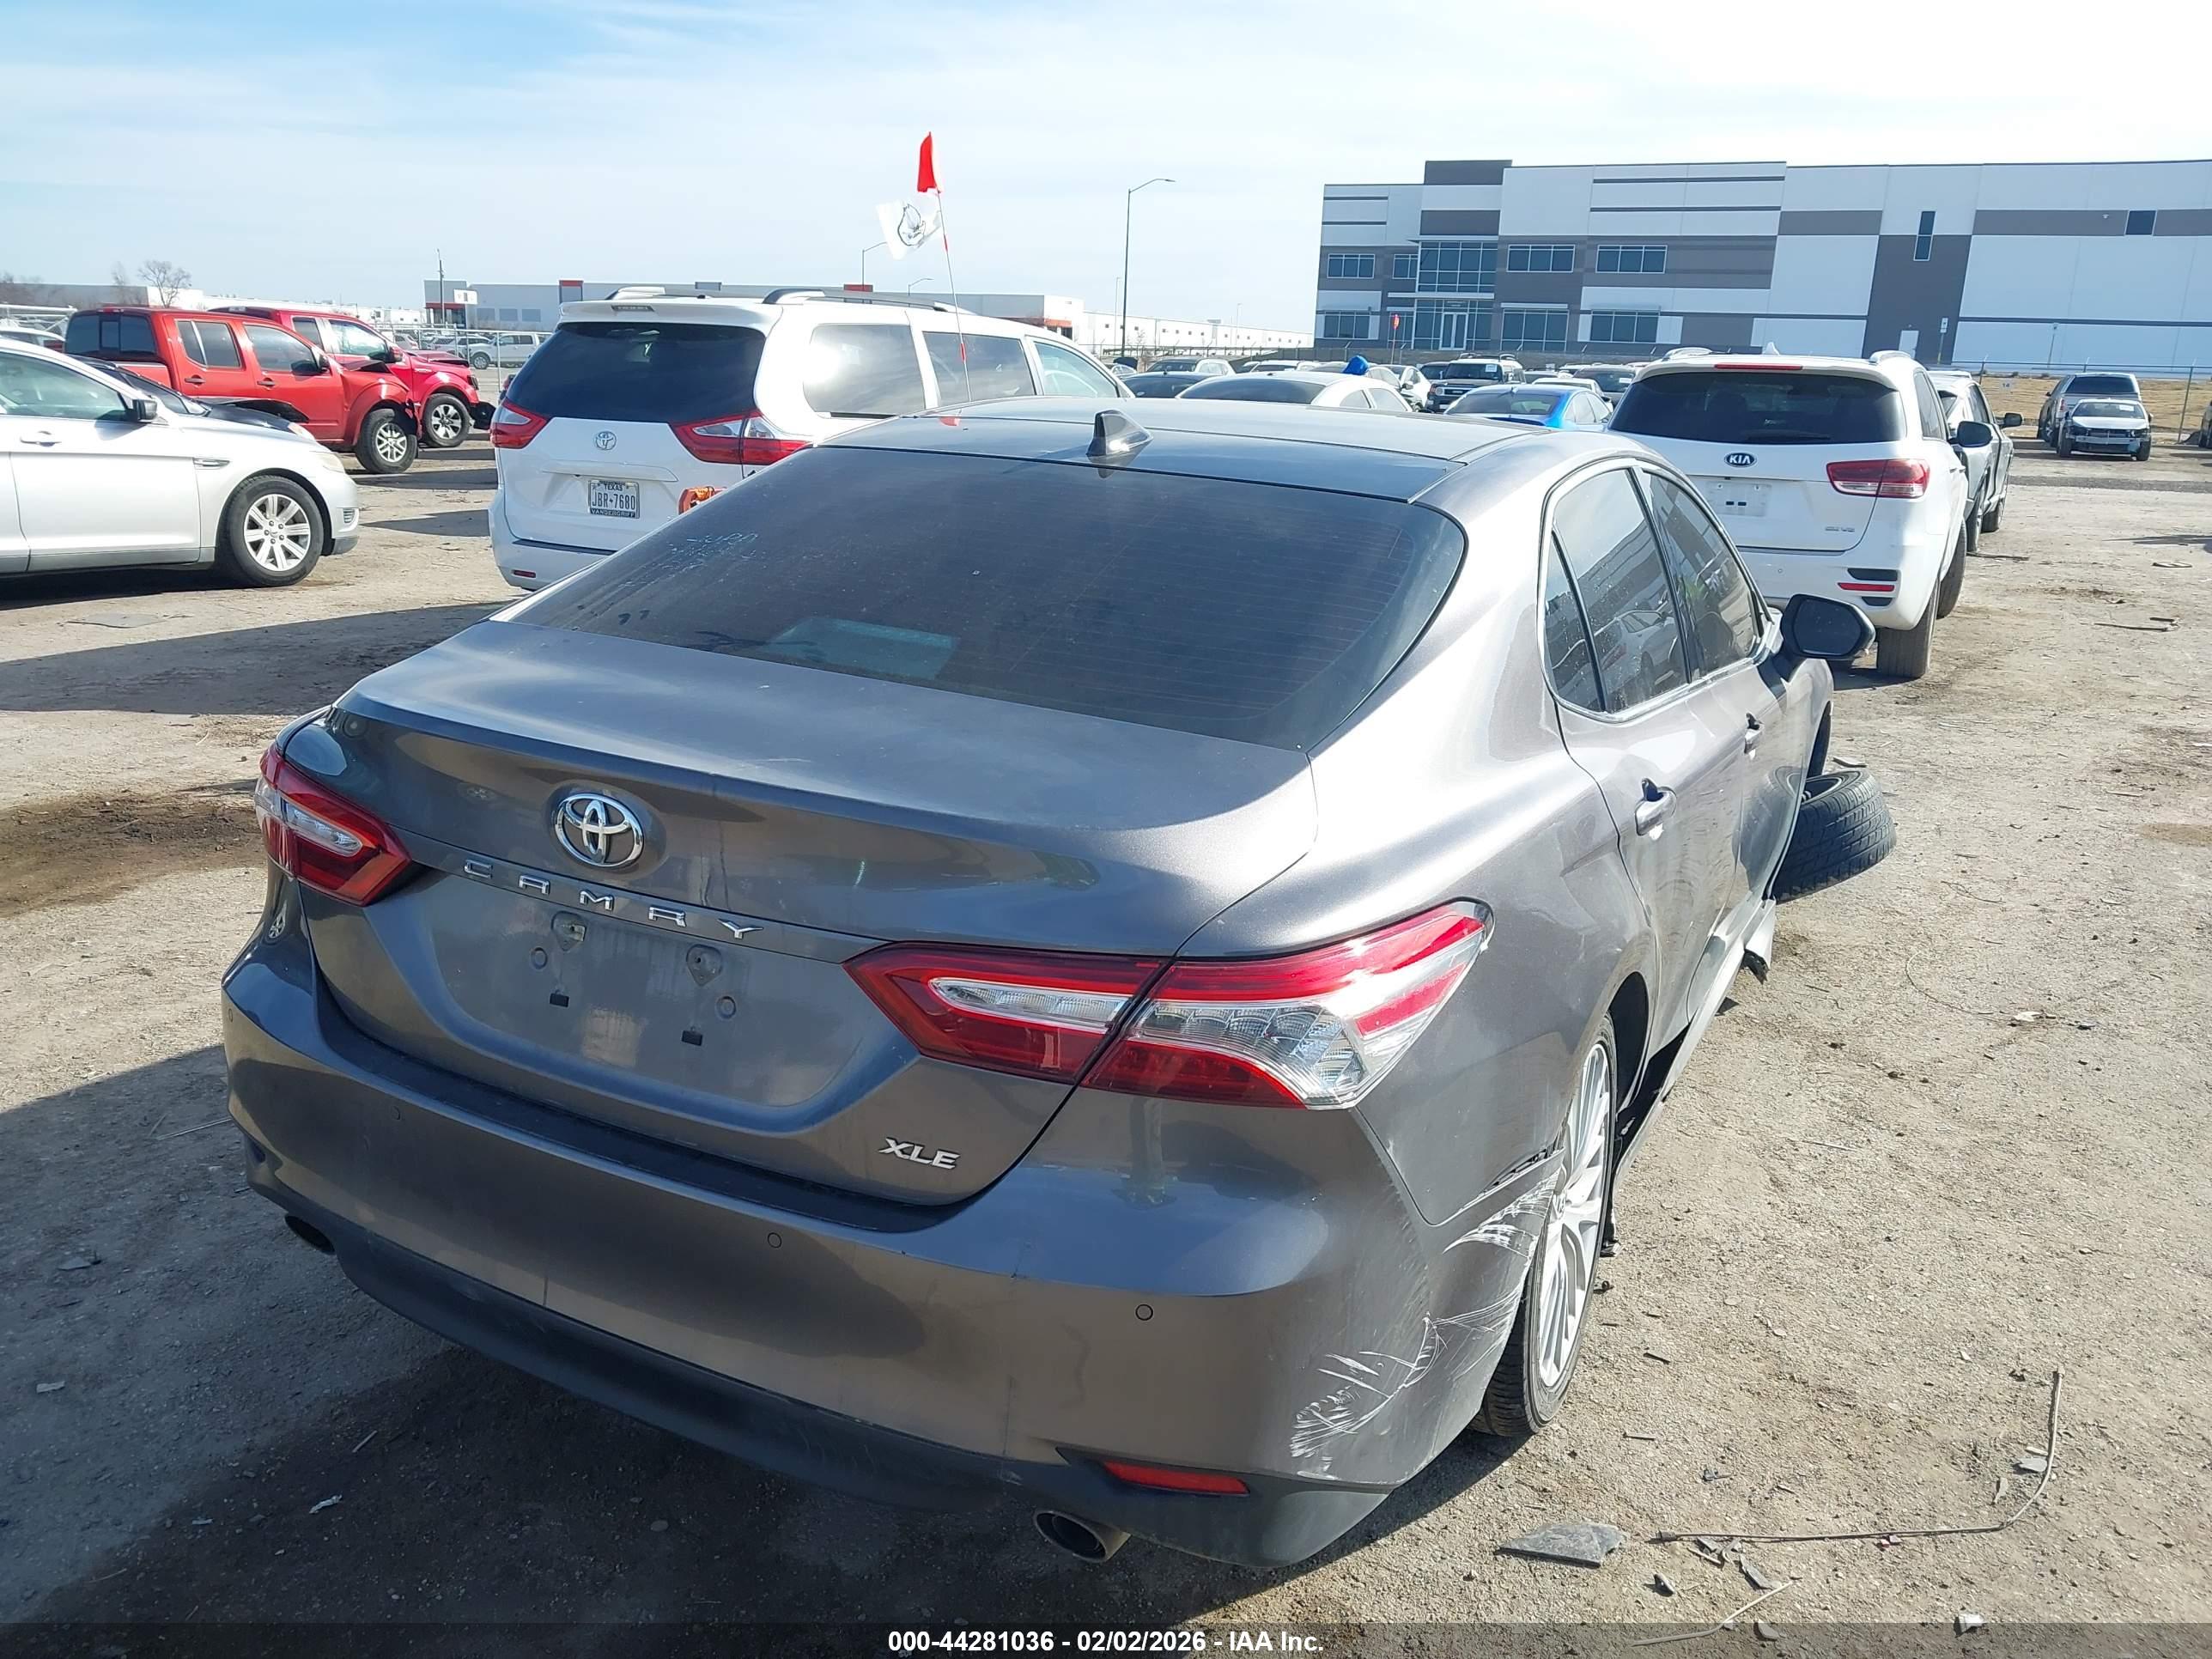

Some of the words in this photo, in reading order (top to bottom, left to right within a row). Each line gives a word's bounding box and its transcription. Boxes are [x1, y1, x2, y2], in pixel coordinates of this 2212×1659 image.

[1729, 455, 1752, 465] KIA
[464, 860, 763, 939] CAMRY
[878, 1138, 961, 1170] XLE
